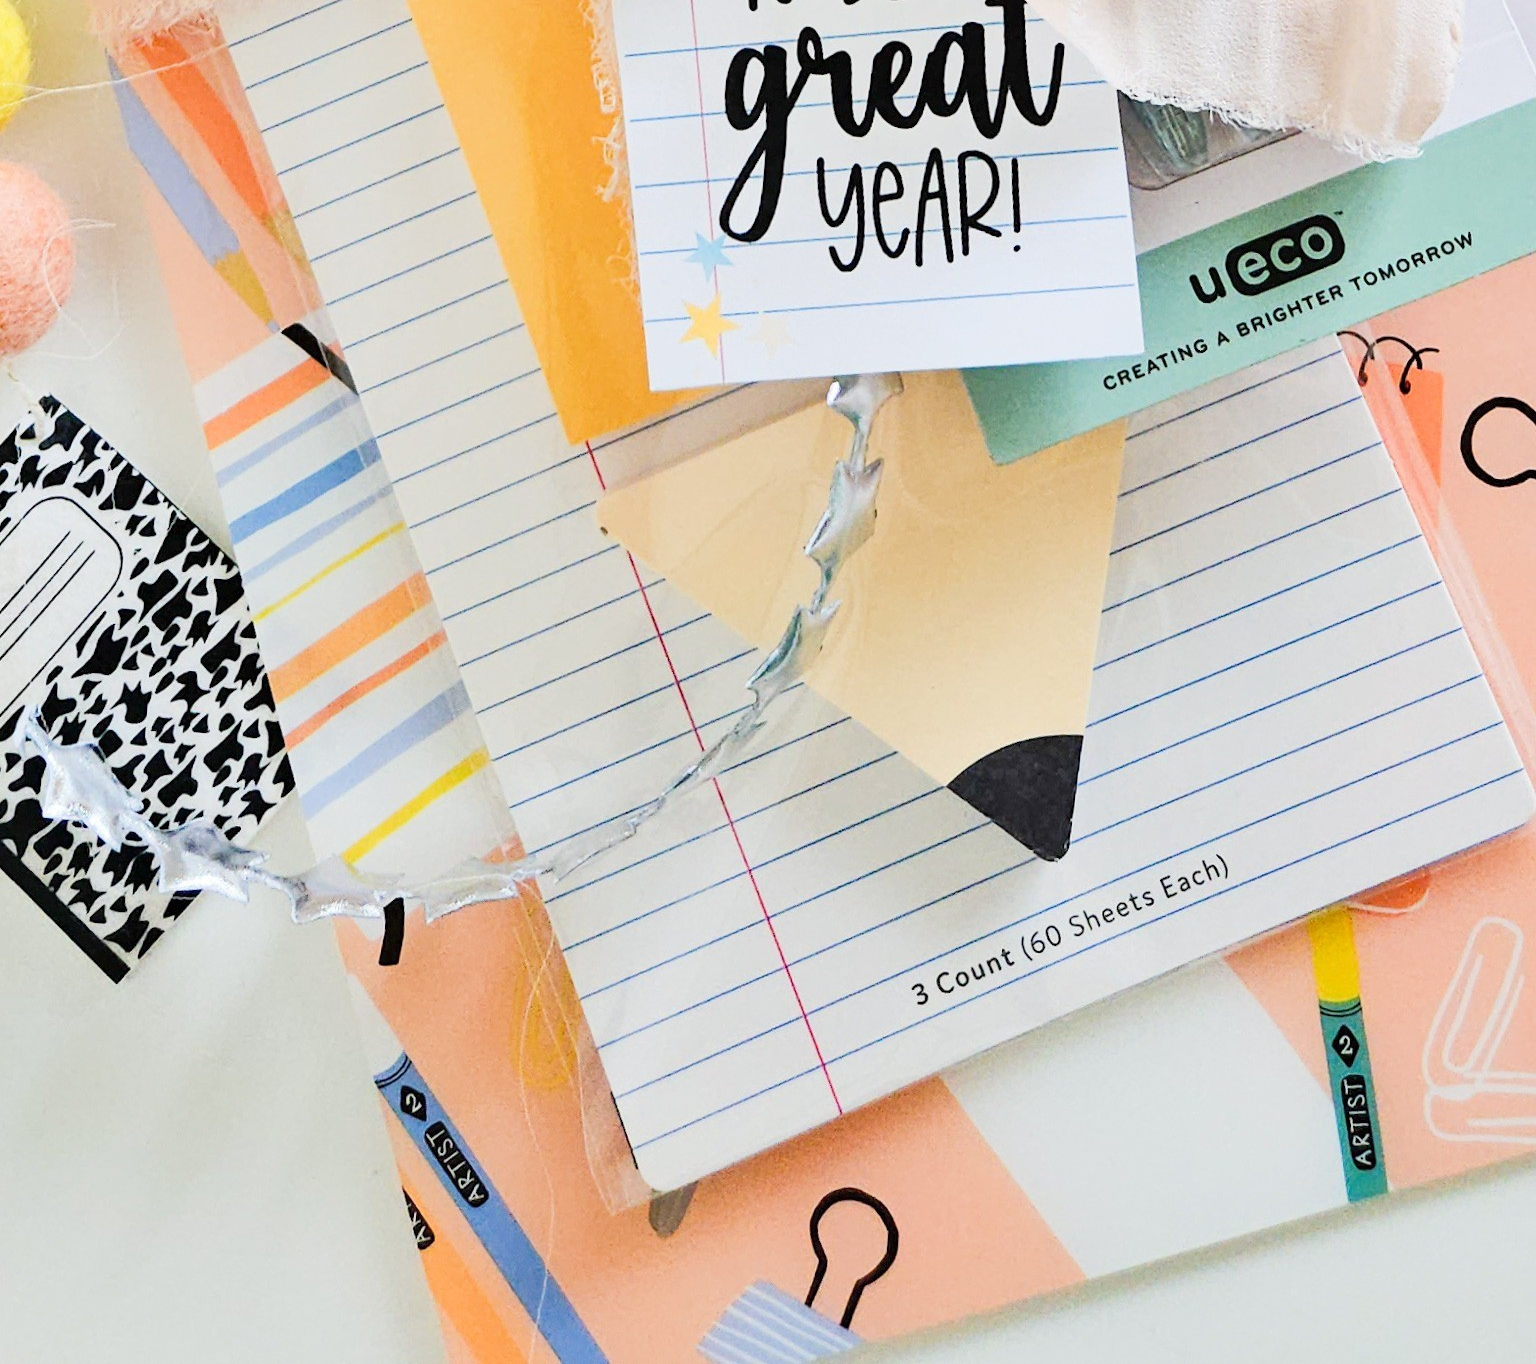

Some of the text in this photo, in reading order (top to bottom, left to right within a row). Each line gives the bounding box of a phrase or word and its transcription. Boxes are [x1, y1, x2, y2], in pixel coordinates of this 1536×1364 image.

[1103, 231, 1474, 391] CREATING A BRIGHTER TOMORROW
[911, 853, 1231, 1006] 3 Count (60 Sheets Each)
[1338, 1034, 1354, 1057] 2
[406, 1093, 422, 1113] 2
[1341, 1078, 1374, 1166] ARTIST
[426, 1129, 485, 1204] ARTIST
